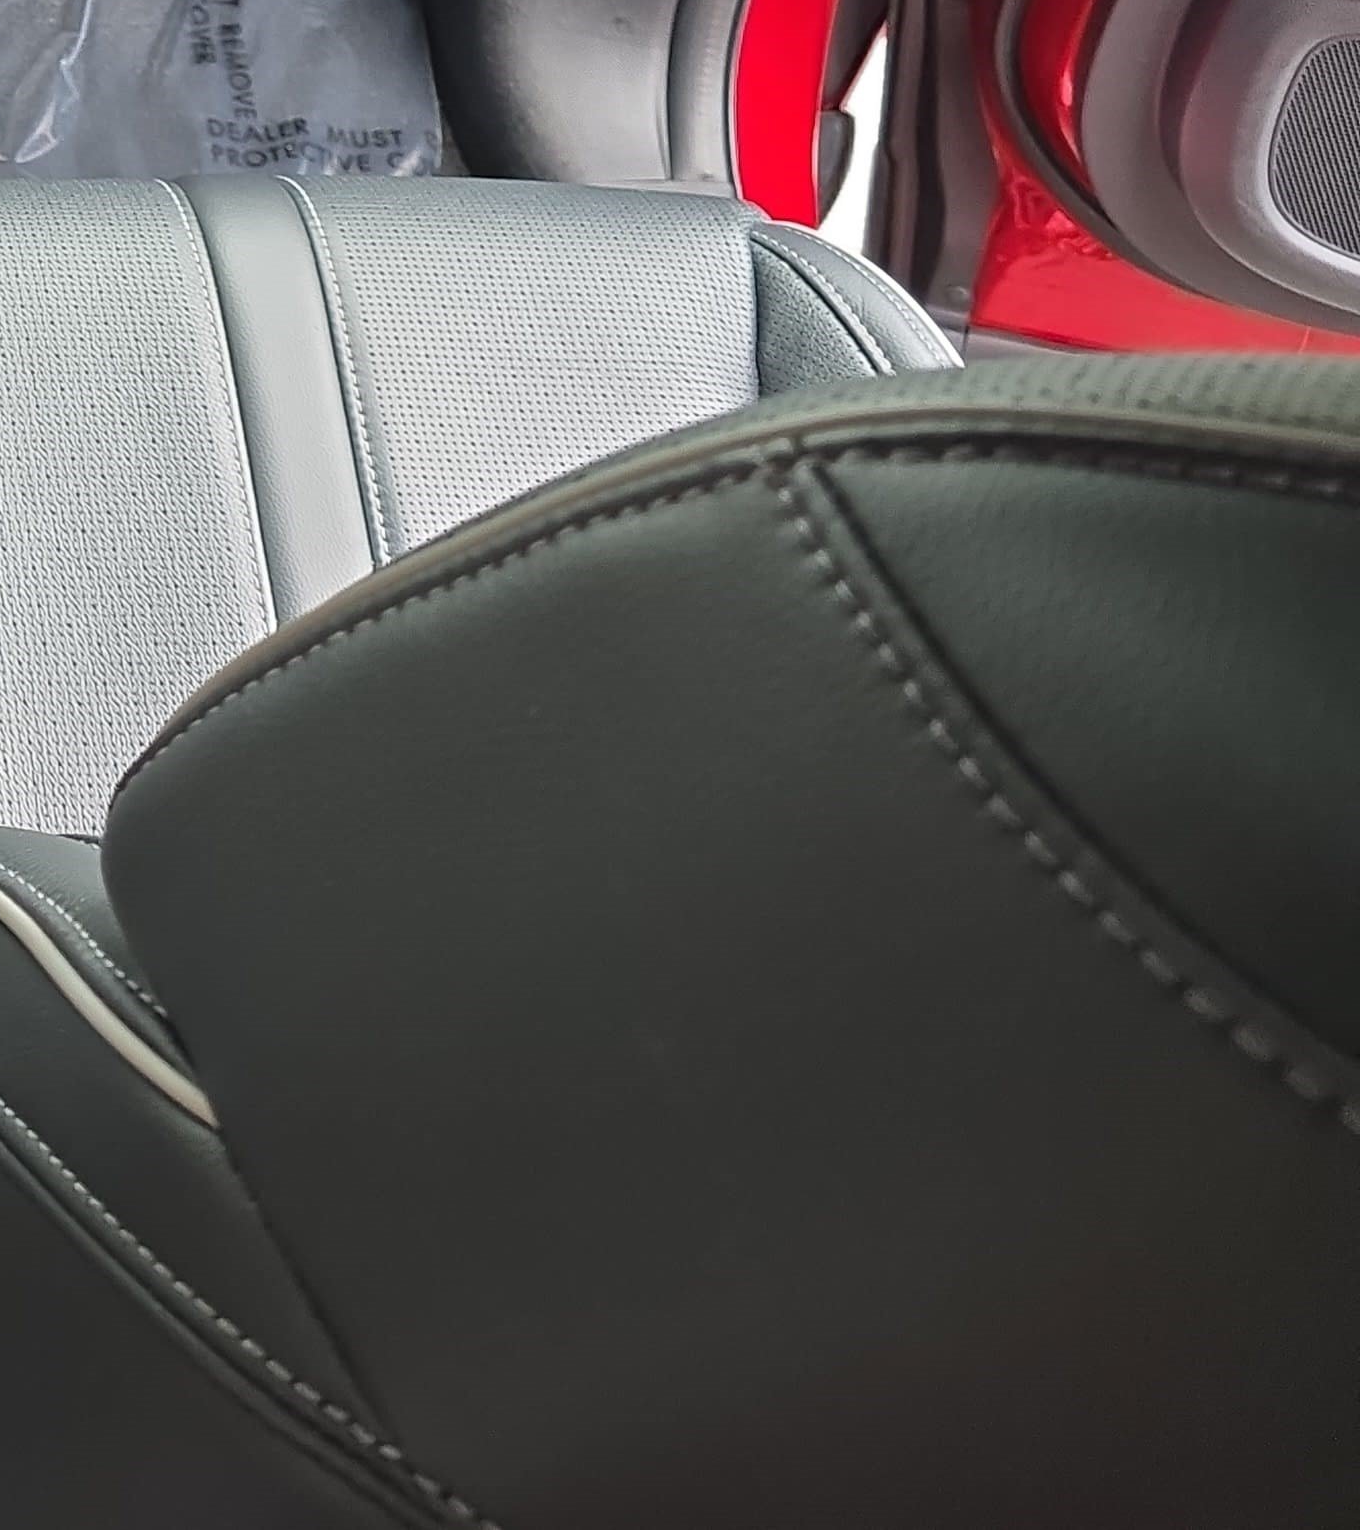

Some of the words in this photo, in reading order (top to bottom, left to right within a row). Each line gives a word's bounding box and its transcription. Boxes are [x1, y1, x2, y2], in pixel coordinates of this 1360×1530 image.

[220, 23, 257, 120] REMOVE
[207, 117, 309, 144] DEALER
[327, 126, 402, 149] MUST
